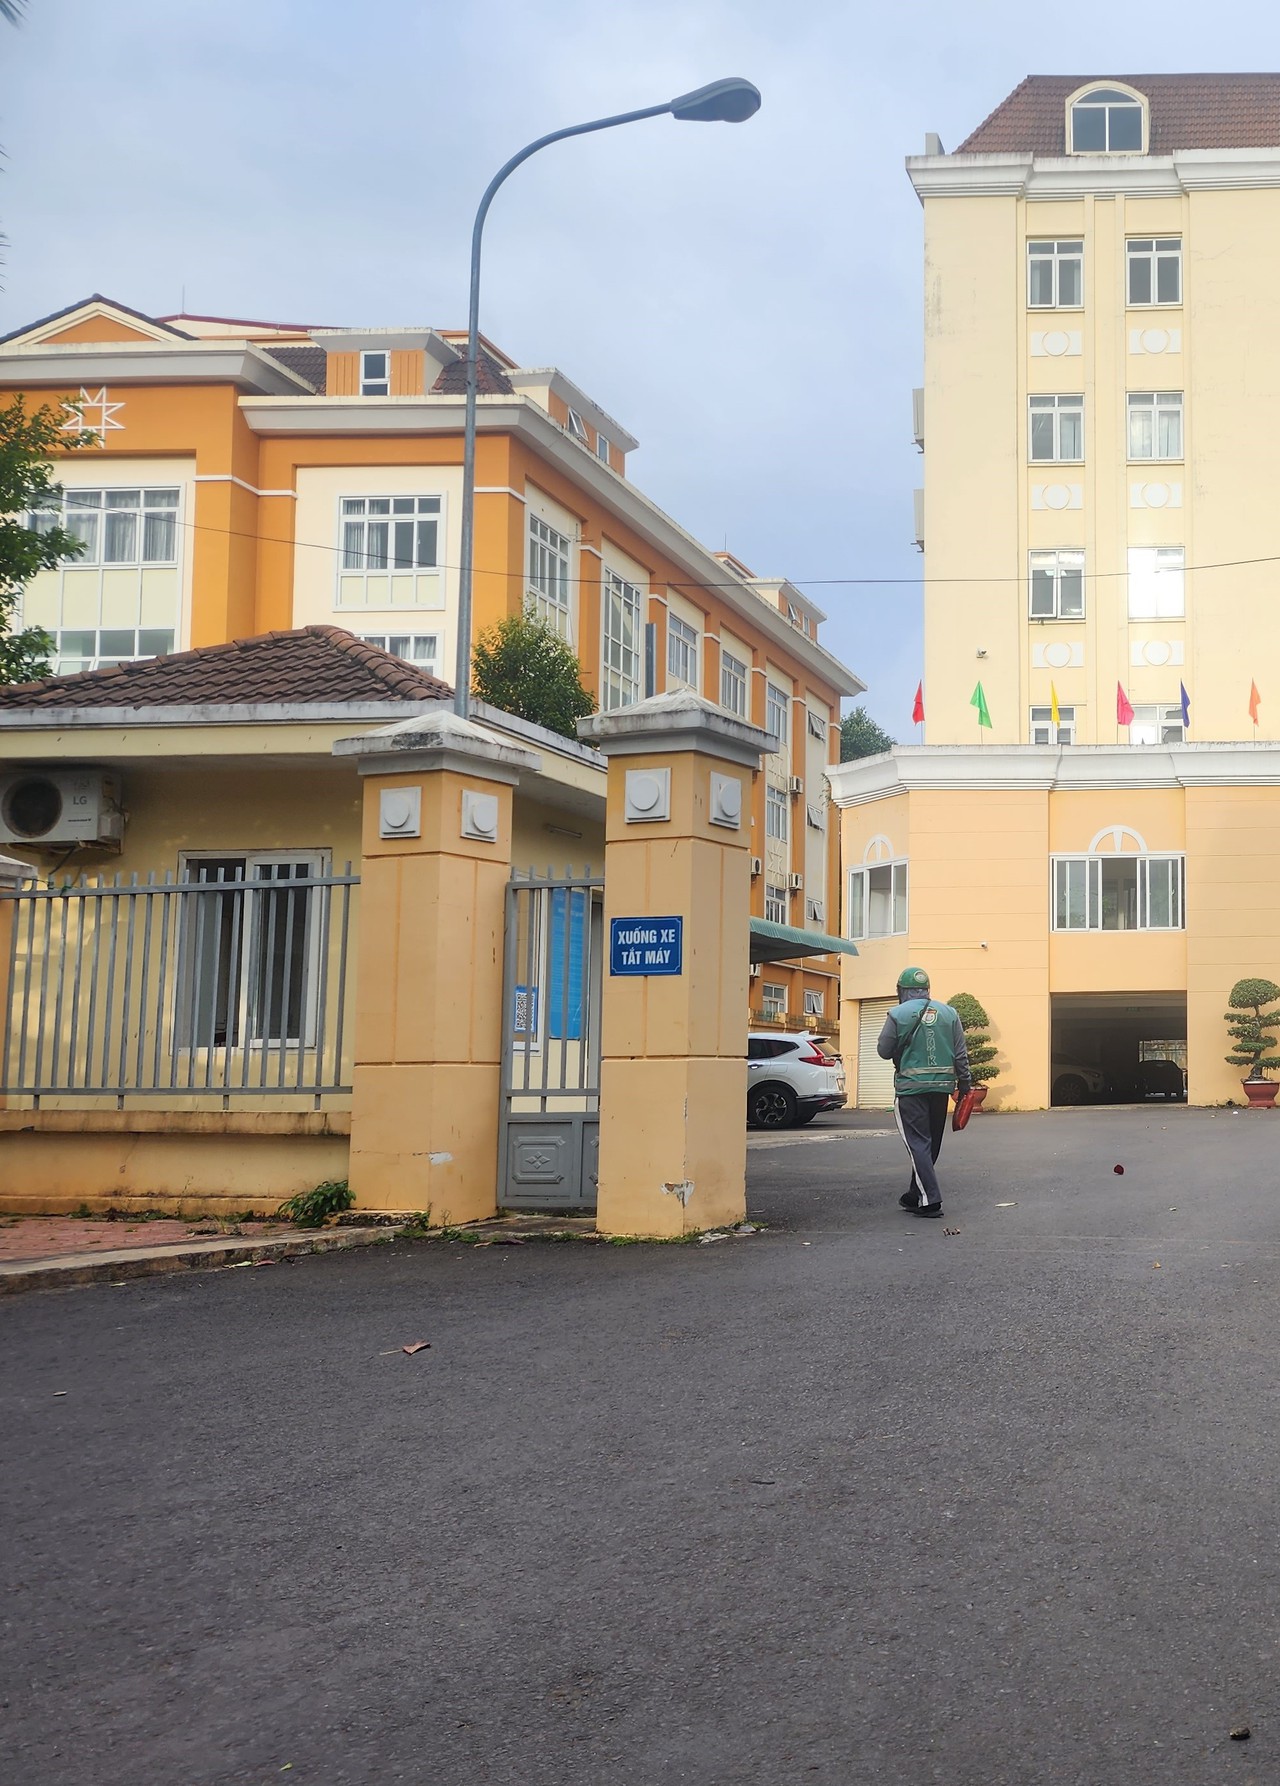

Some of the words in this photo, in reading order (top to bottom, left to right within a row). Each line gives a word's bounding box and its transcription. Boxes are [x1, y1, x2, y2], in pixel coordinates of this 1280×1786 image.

[72, 795, 88, 806] LG
[617, 925, 658, 945] XUỐNG
[660, 929, 676, 944] XE
[621, 946, 642, 966] TẮT
[644, 946, 671, 965] MÁY
